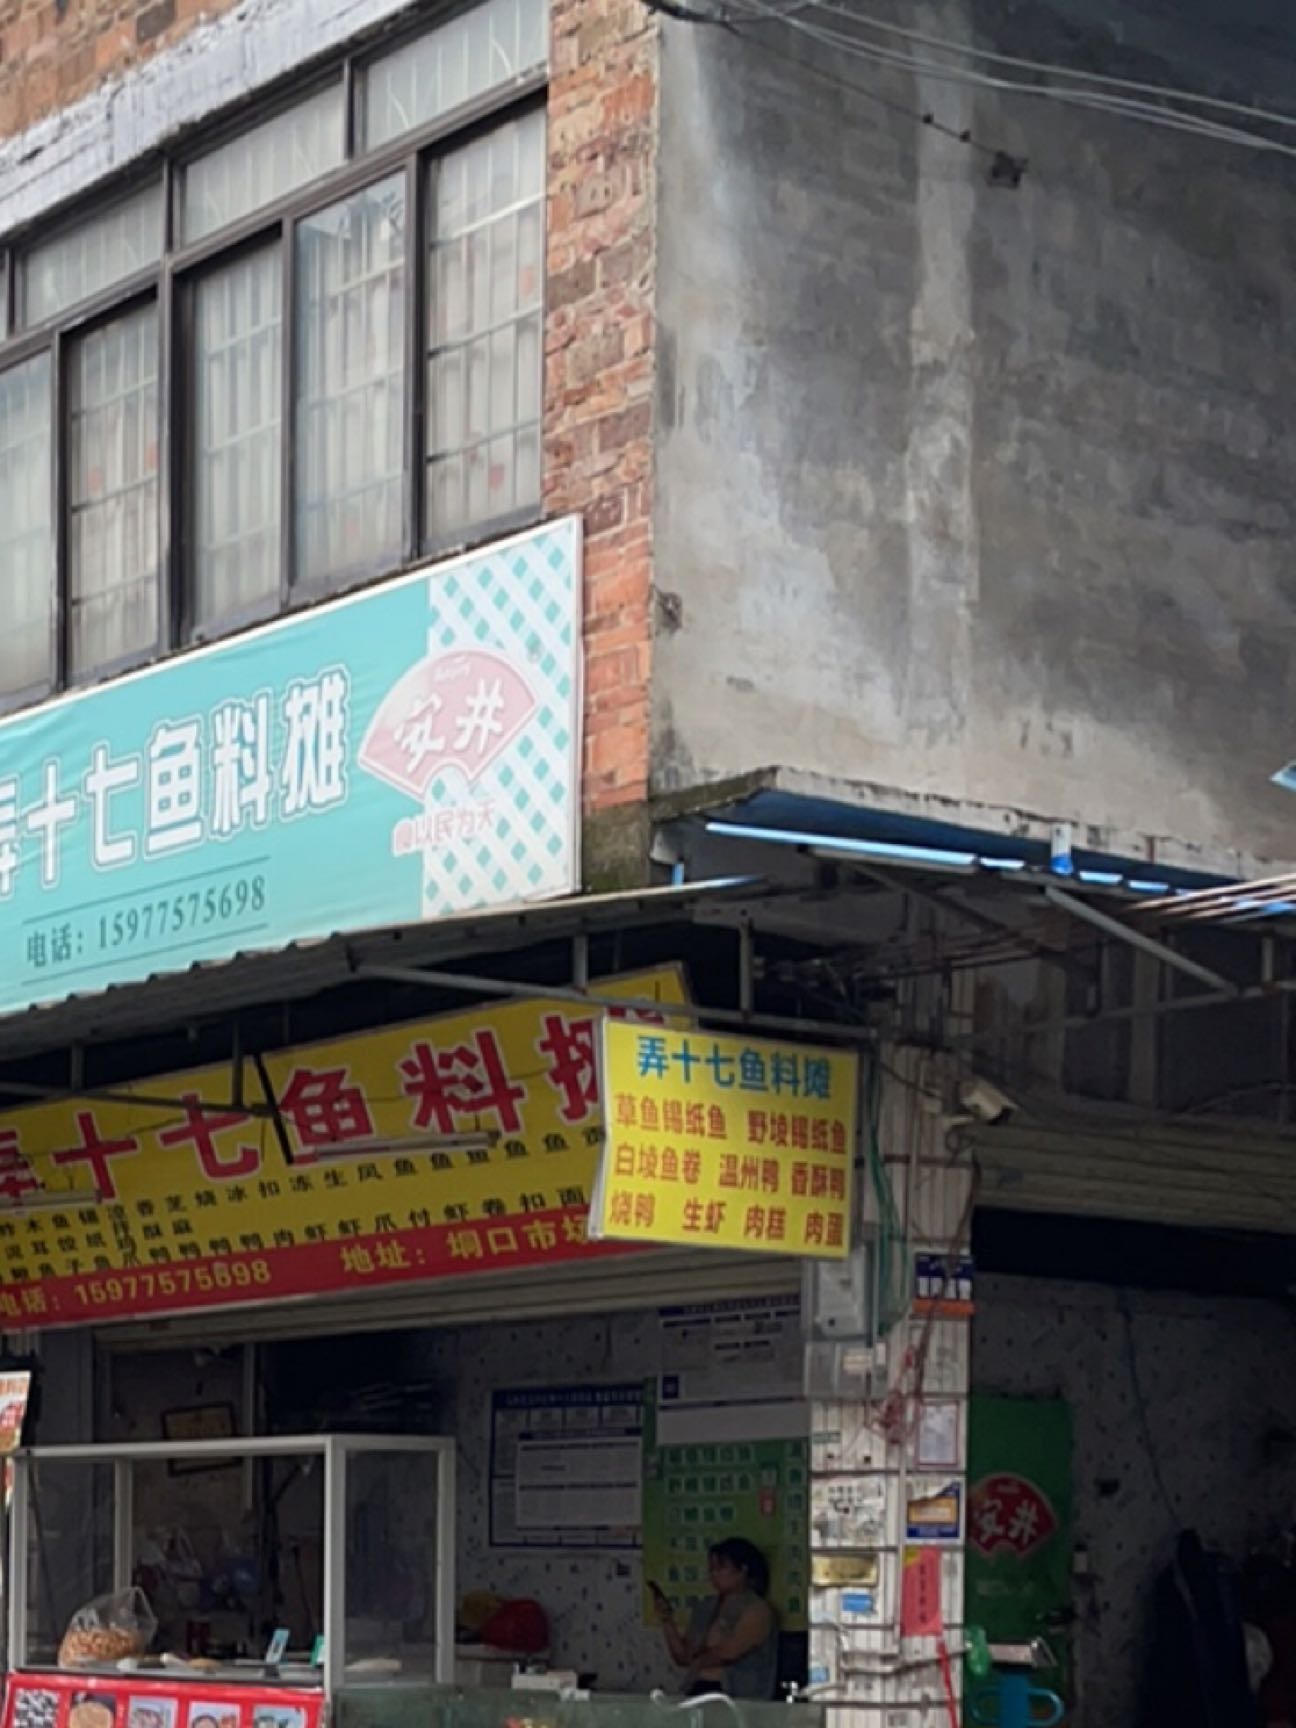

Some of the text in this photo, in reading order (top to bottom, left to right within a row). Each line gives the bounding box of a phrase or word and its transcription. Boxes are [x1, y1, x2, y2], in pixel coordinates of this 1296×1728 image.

[394, 678, 505, 774] 安井
[25, 874, 267, 967] 电话： 15977575698
[637, 1035, 832, 1100] 弄十七鱼料摊
[74, 1259, 272, 1307] 15977575698
[972, 1499, 1040, 1544] 安井
